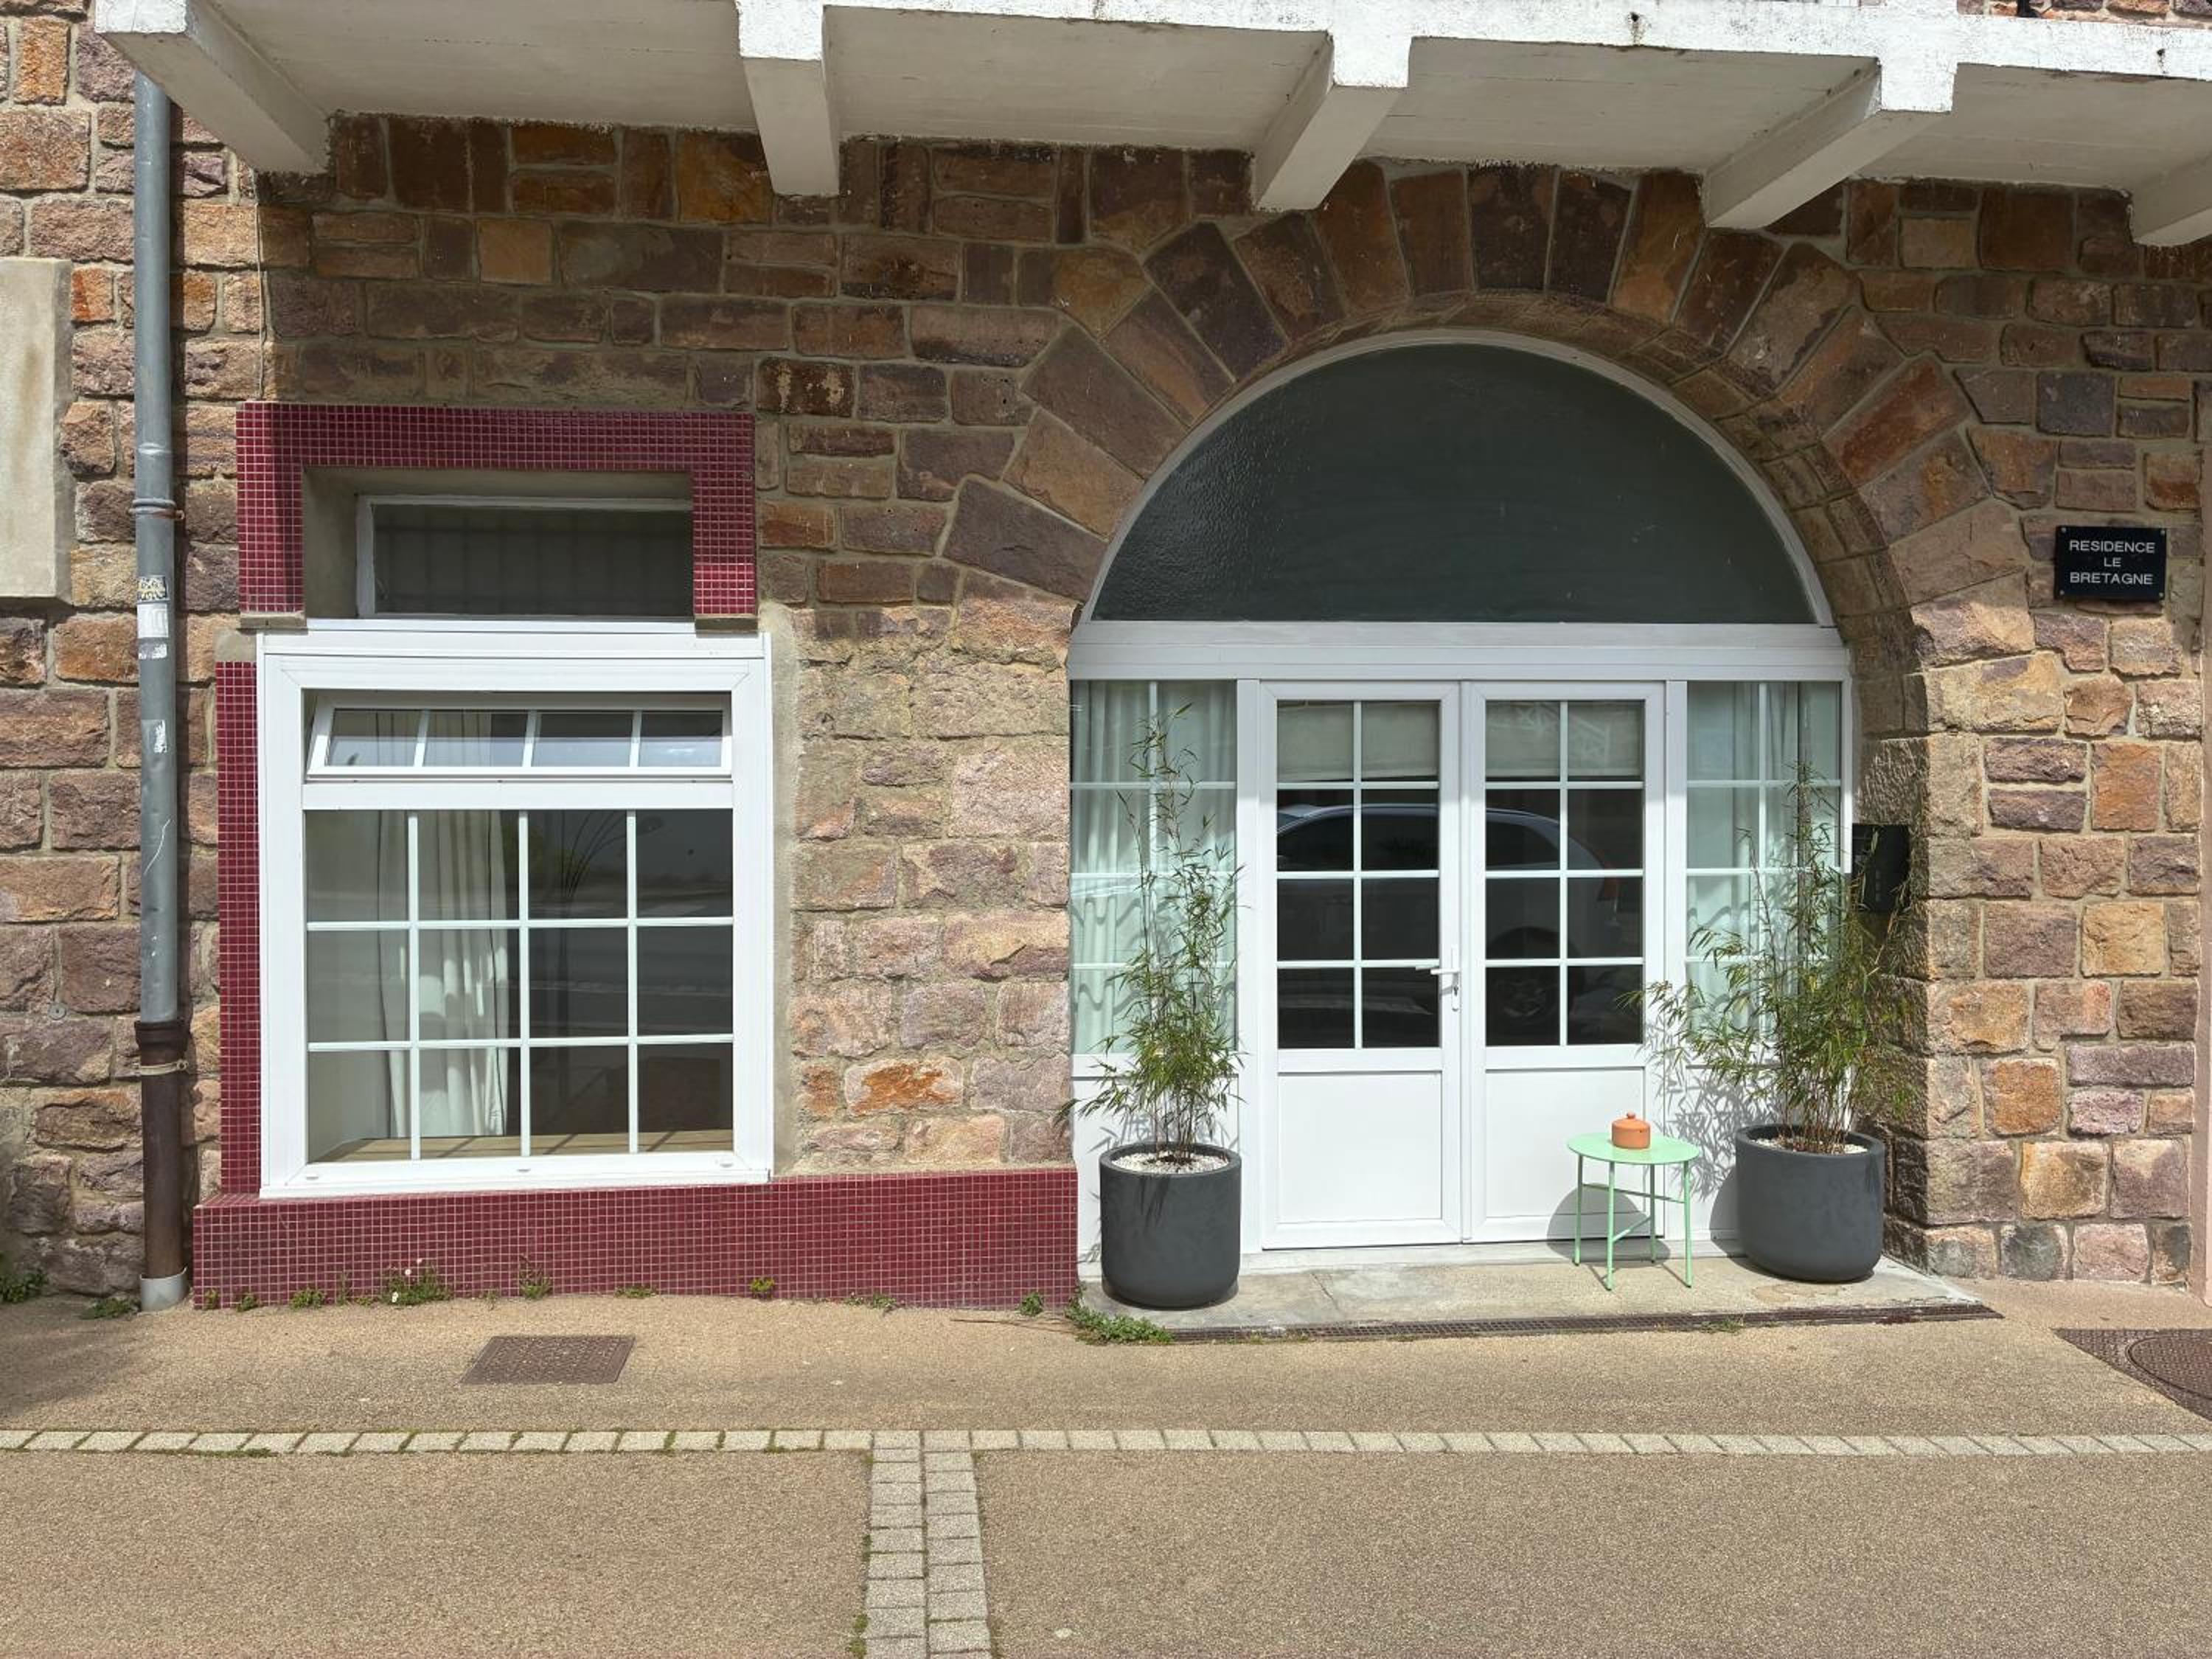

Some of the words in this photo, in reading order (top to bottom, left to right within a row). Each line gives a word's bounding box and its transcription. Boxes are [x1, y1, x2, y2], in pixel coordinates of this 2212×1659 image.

[2069, 540, 2155, 553] RESIDENCE
[2104, 557, 2121, 567] LE
[2070, 571, 2153, 585] BRETAGNE
